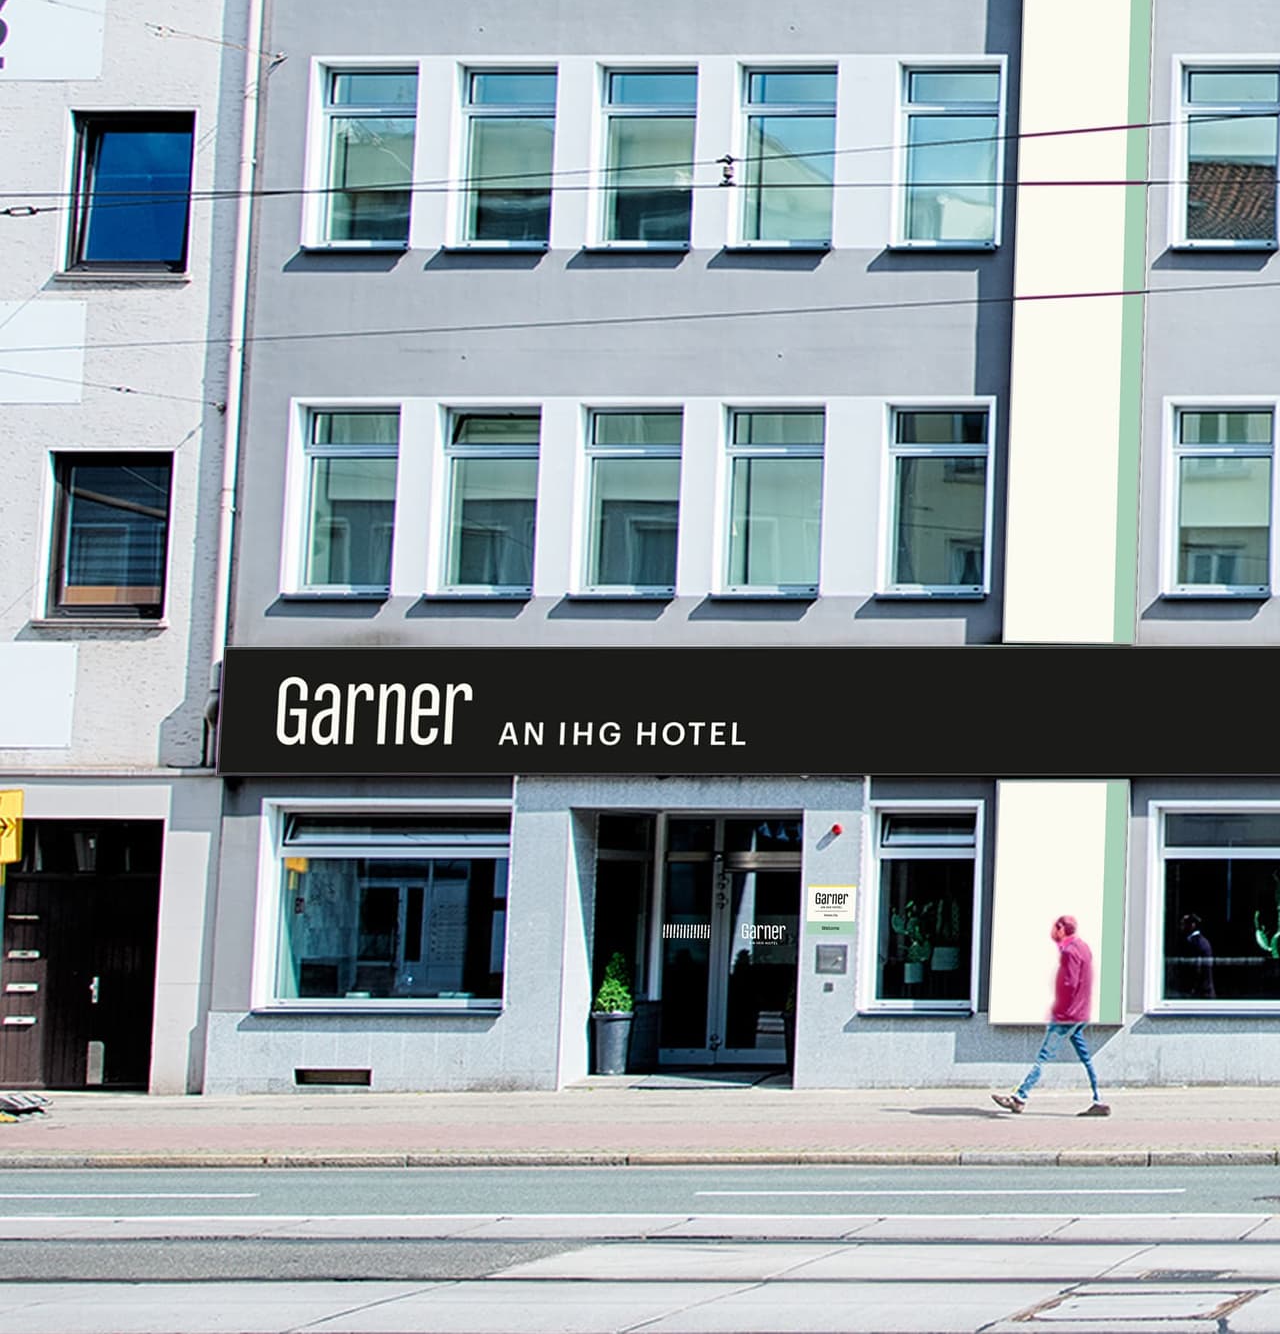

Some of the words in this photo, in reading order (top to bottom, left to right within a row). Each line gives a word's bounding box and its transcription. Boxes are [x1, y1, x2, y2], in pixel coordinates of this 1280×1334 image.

[276, 676, 473, 746] Garner
[498, 721, 545, 746] AN
[559, 721, 621, 746] IHG
[636, 721, 747, 746] HOTEL
[815, 892, 849, 905] Garner
[741, 922, 786, 940] Garner
